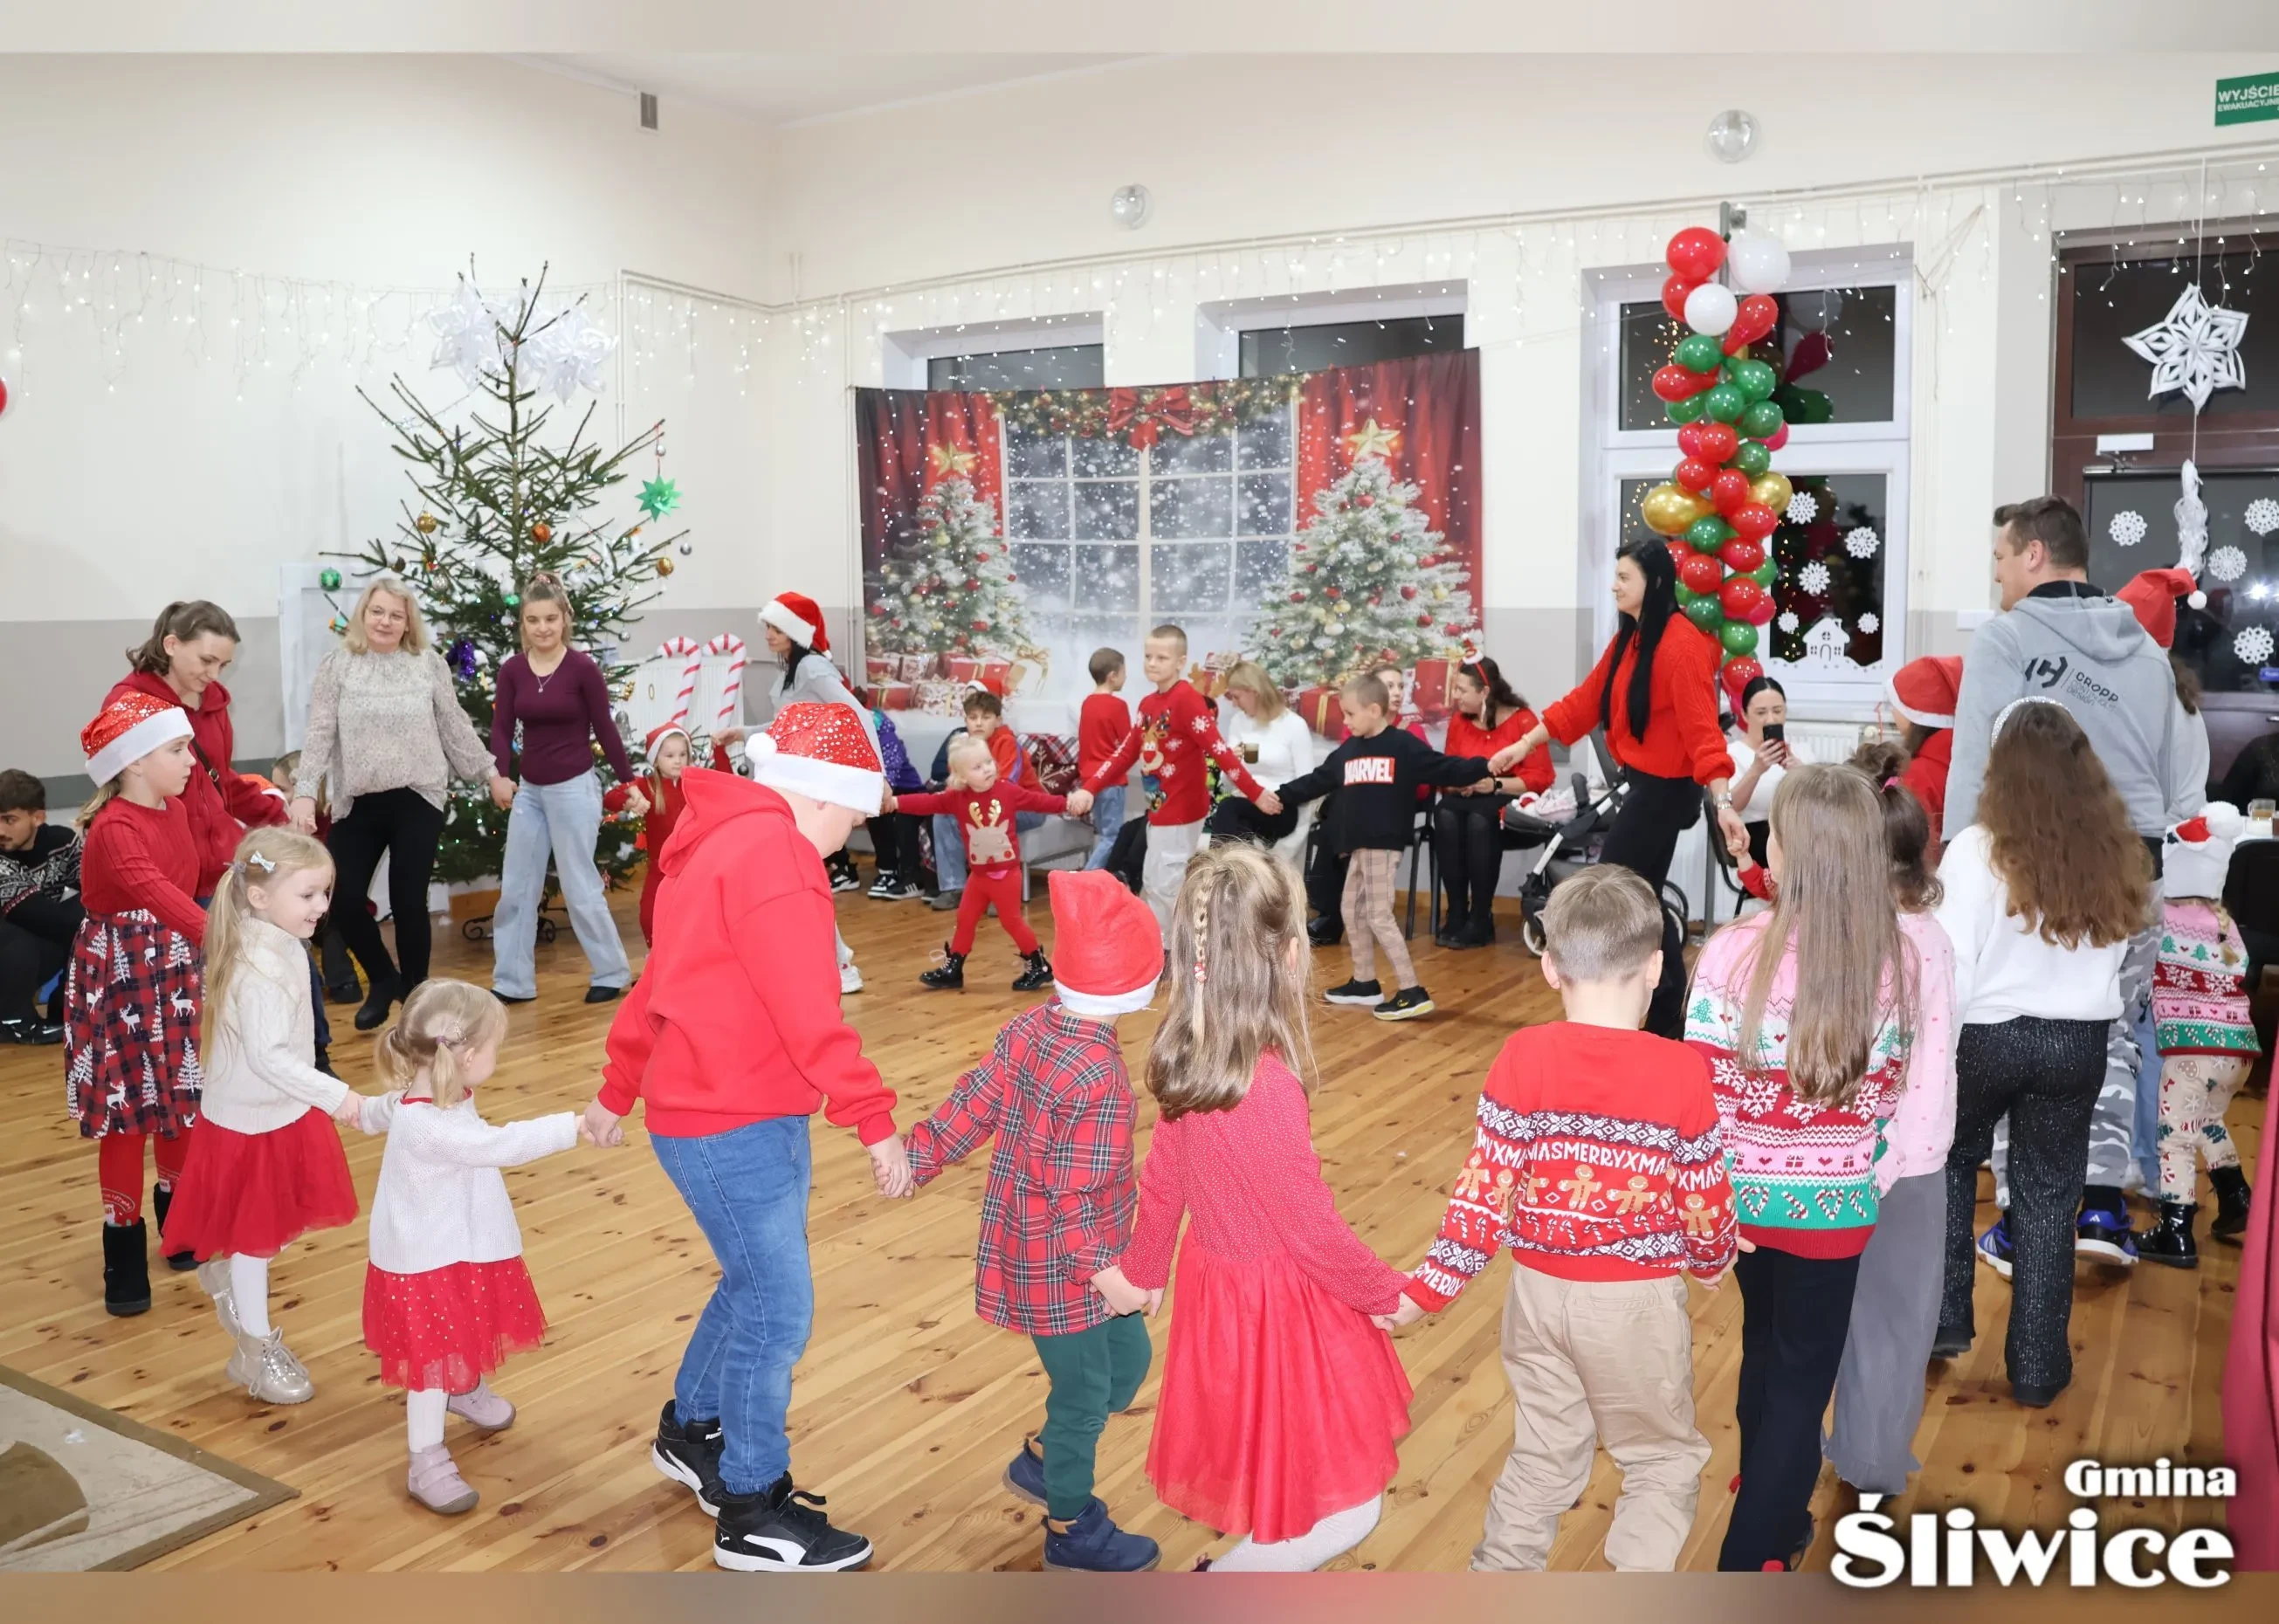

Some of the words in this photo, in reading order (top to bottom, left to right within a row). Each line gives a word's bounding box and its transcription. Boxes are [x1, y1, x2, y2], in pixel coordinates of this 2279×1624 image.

[2218, 84, 2279, 103] WYJŚCIE
[2076, 671, 2118, 702] CROPP
[1344, 757, 1394, 786] MARVEL
